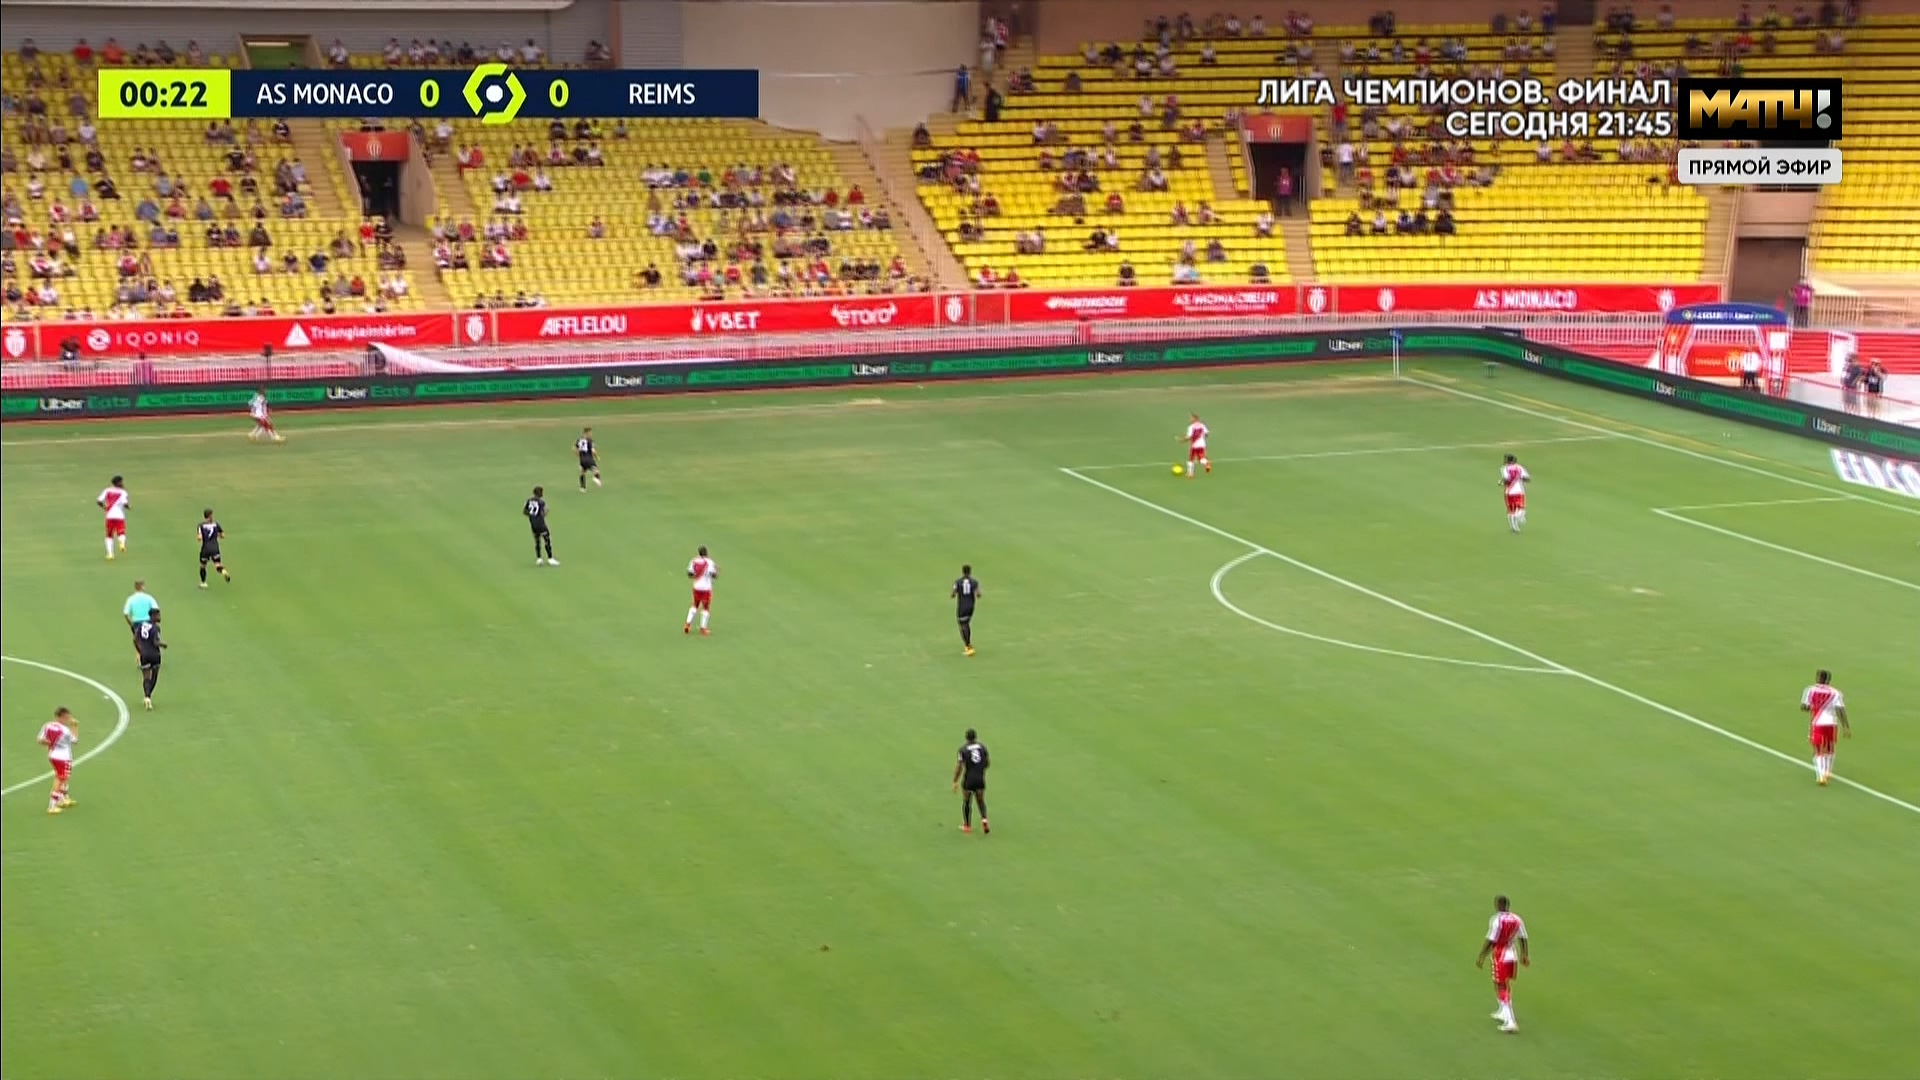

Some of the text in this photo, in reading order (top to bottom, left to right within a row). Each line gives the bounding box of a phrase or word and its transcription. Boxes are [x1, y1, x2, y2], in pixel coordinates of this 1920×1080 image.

[1473, 289, 1578, 310] AS MONACO
[539, 315, 628, 336] AFFLELOU
[706, 311, 761, 331] VBET
[115, 330, 200, 346] IQONIQ
